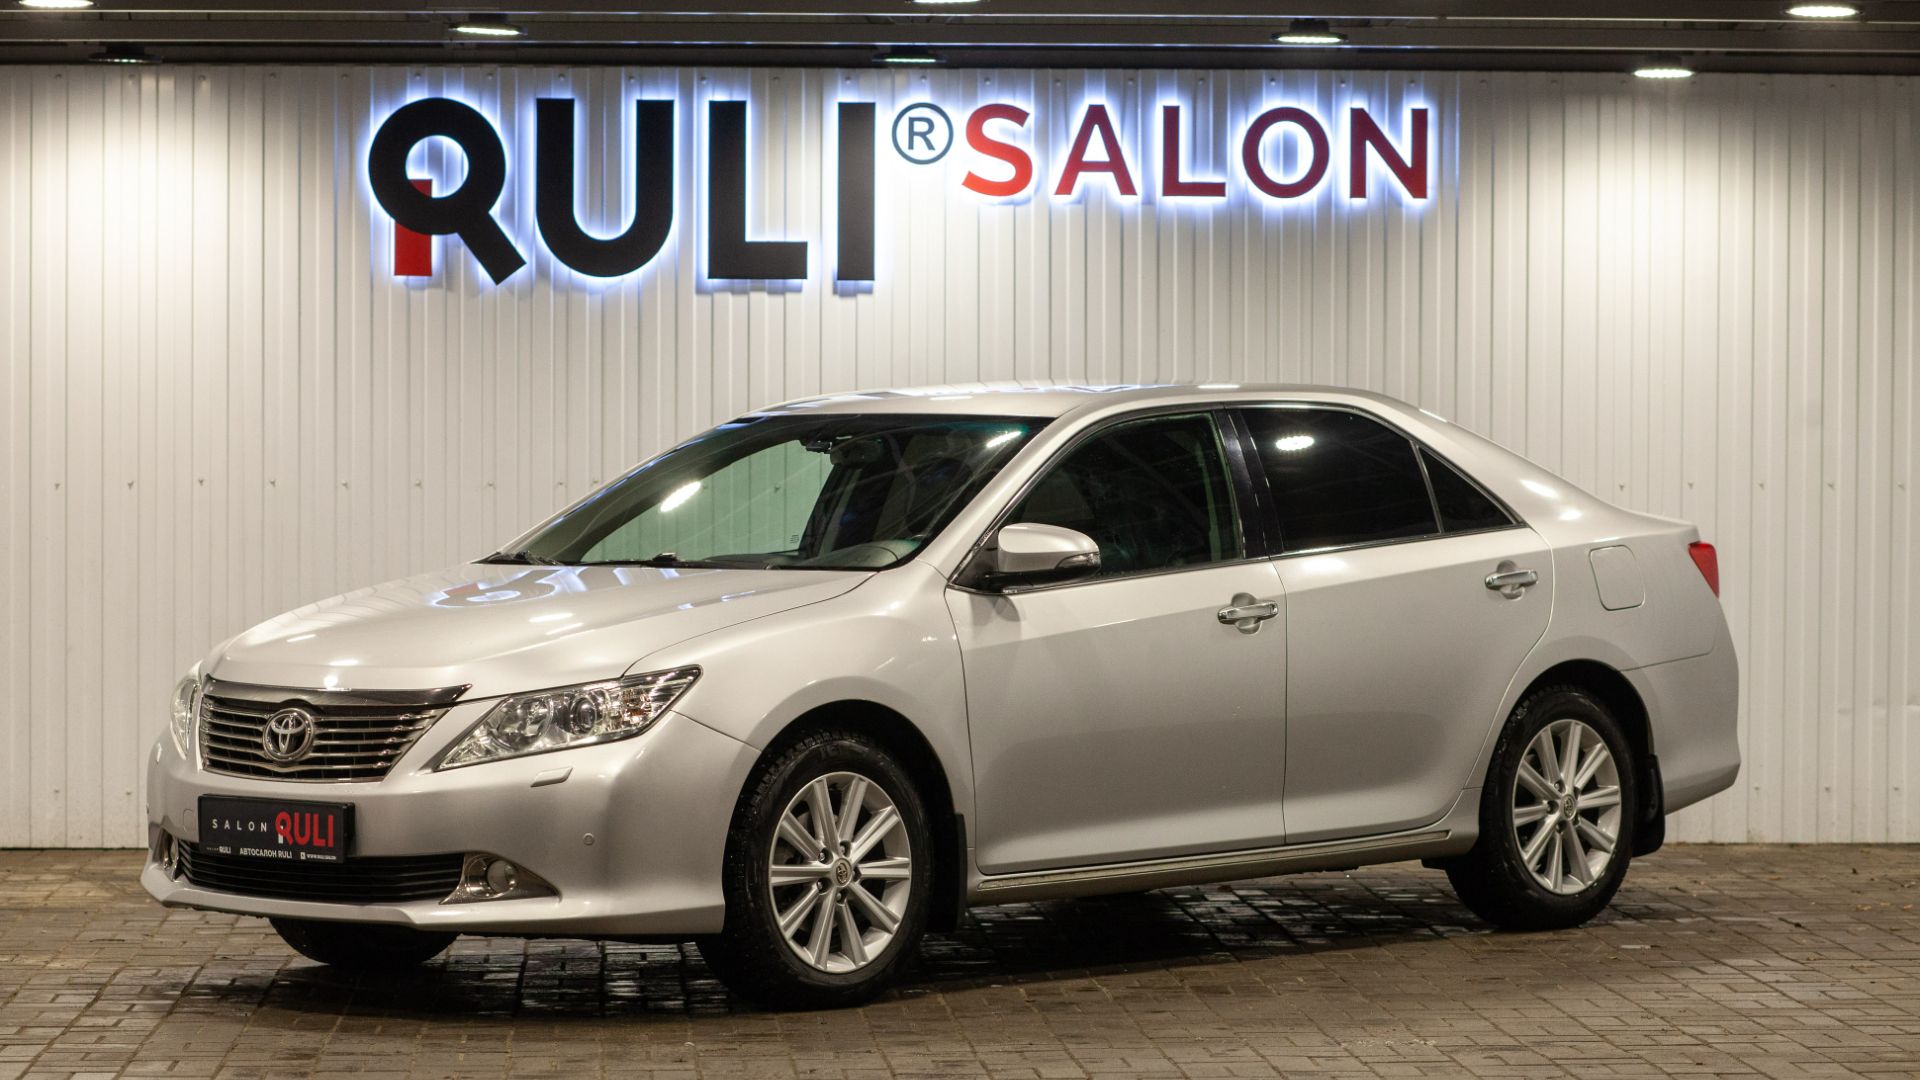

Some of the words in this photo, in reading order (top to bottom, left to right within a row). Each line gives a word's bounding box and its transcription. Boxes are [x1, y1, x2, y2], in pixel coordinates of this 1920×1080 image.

[961, 102, 1429, 200] SALON
[211, 818, 268, 833] SALON
[239, 847, 277, 858] АВТОСАЛОН
